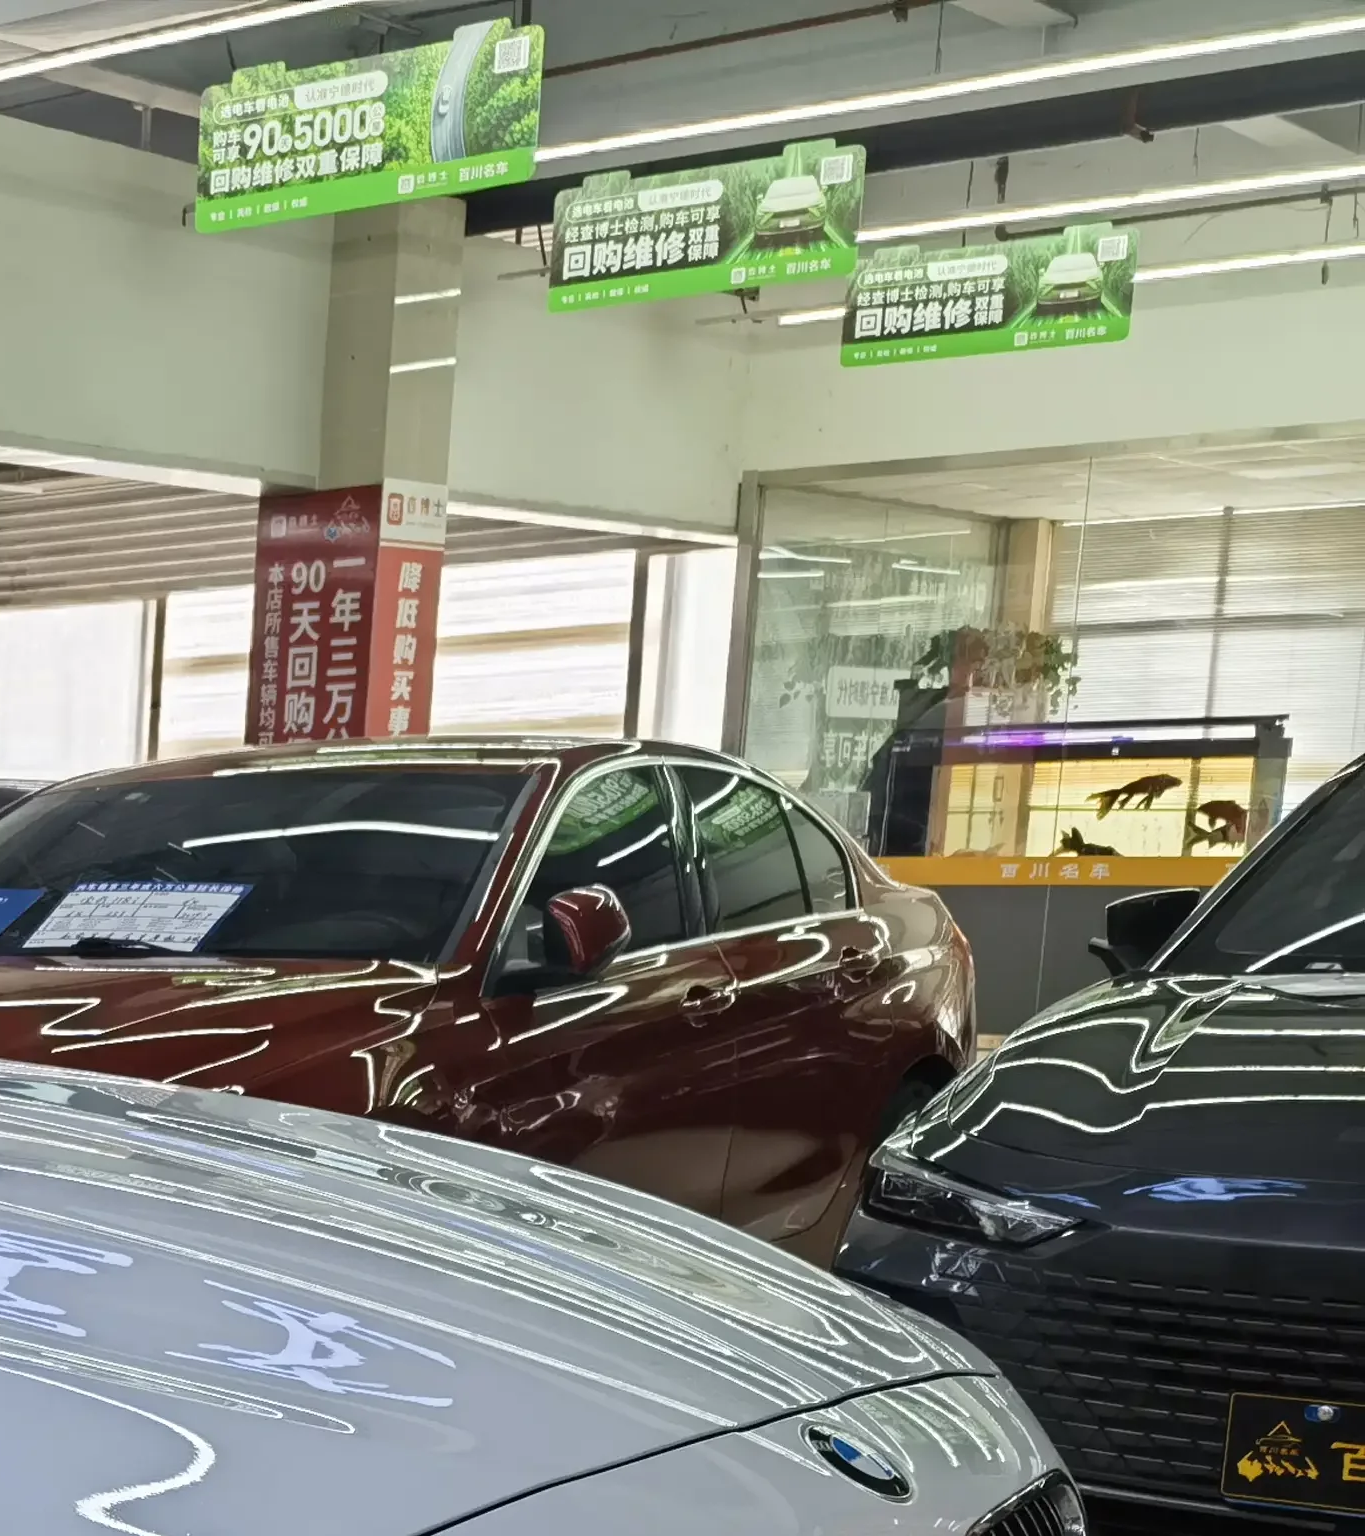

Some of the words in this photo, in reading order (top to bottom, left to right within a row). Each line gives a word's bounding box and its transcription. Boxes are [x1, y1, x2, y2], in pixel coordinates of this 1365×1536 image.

[209, 142, 383, 196] 回购维修双重保障
[561, 231, 687, 281] 回购维修
[853, 298, 973, 340] 回购维修
[282, 559, 326, 744] 90天回购
